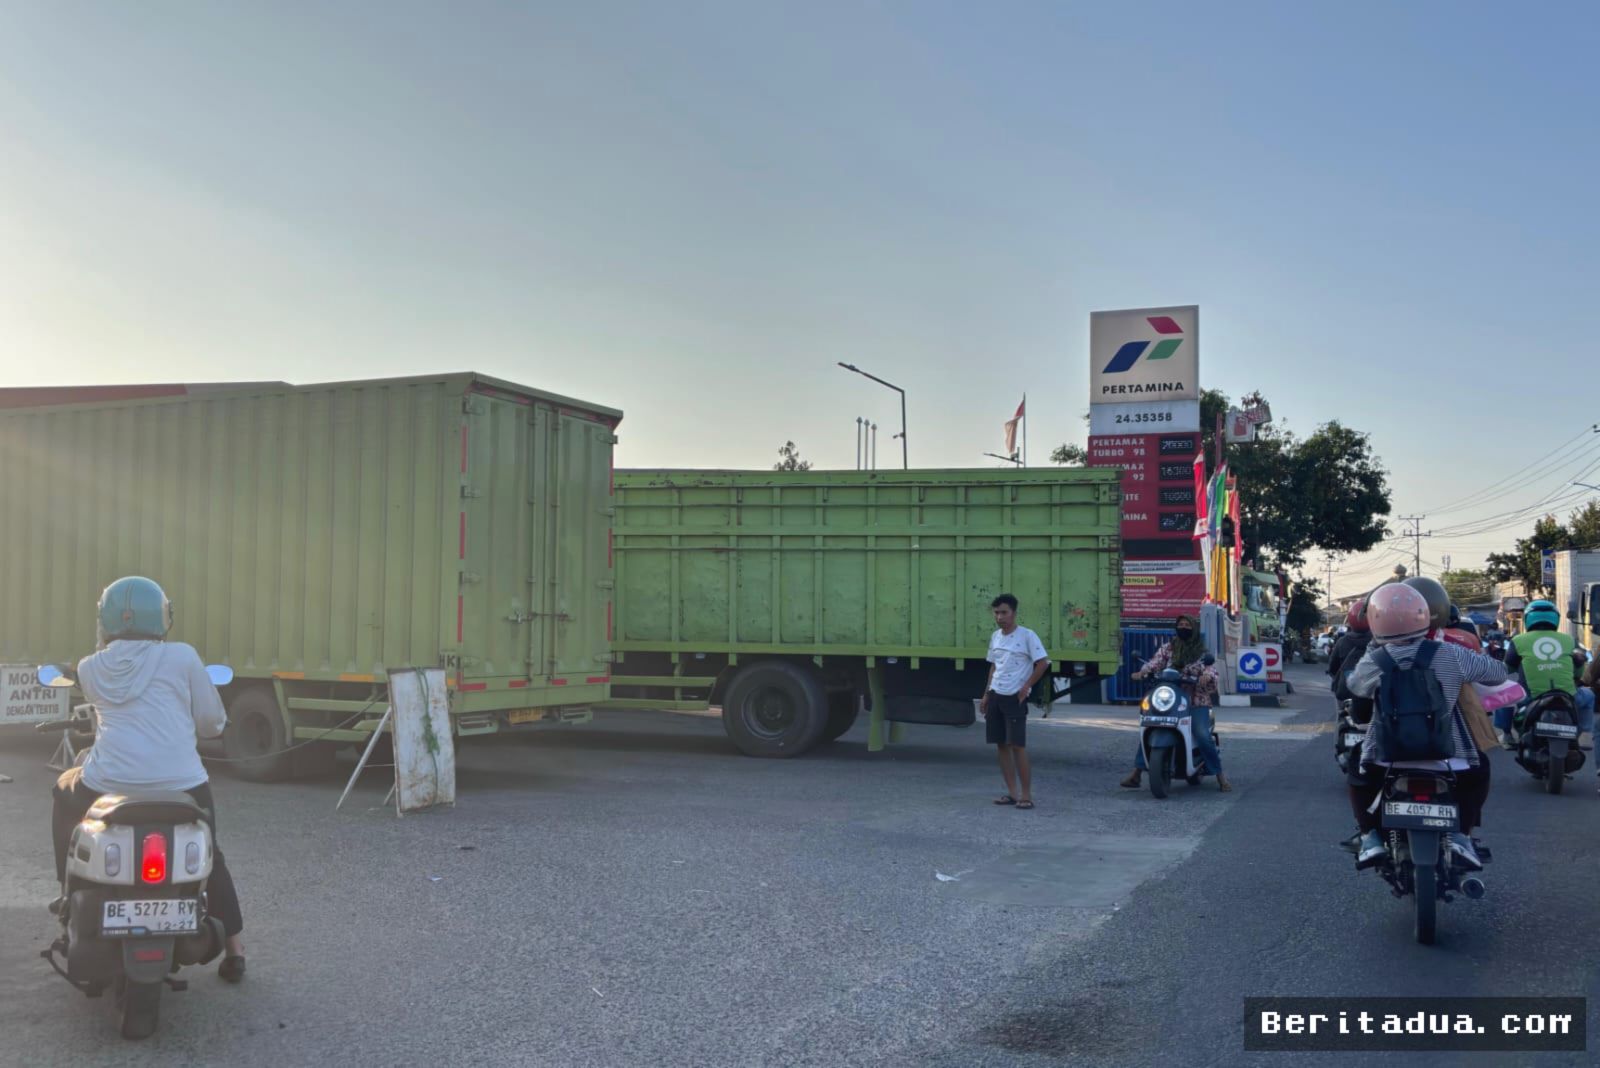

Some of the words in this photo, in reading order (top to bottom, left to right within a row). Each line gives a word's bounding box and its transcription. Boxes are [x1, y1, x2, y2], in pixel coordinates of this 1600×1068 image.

[1102, 381, 1184, 394] PERTAMINA
[1115, 412, 1172, 424] 24.35358
[1093, 437, 1145, 446] PERTAMAX
[1093, 448, 1125, 457] TURBO
[1133, 448, 1146, 456] 98
[1132, 473, 1145, 481] 92
[1240, 682, 1264, 690] MASUK
[10, 688, 57, 700] ANTRI
[1386, 803, 1400, 814] BE
[107, 904, 126, 918] BE
[134, 902, 168, 917] 5272
[178, 901, 194, 914] RY
